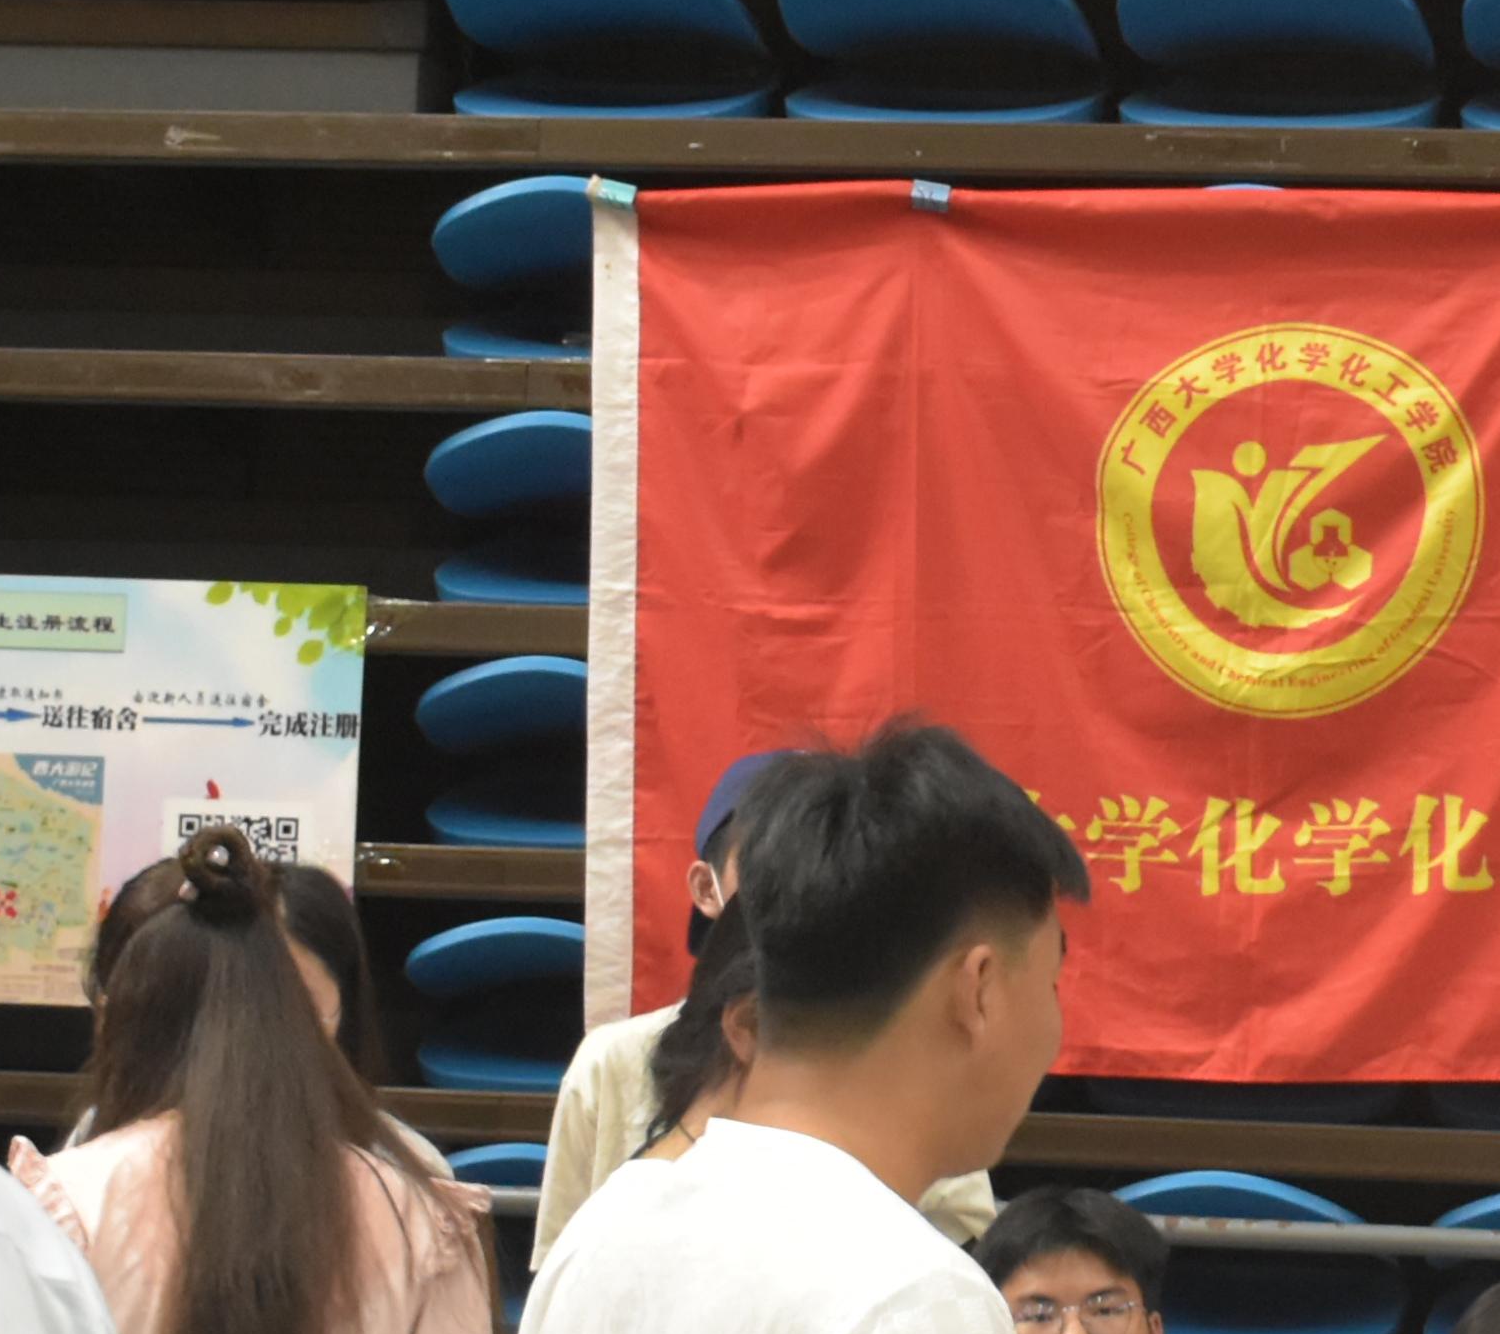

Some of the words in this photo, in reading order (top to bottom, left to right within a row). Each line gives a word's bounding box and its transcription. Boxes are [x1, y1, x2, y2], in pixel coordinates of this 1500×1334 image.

[1121, 341, 1459, 476] 广西大学化学化工学院
[41, 704, 139, 731] 送往宿舍
[257, 711, 360, 738] 完成注册
